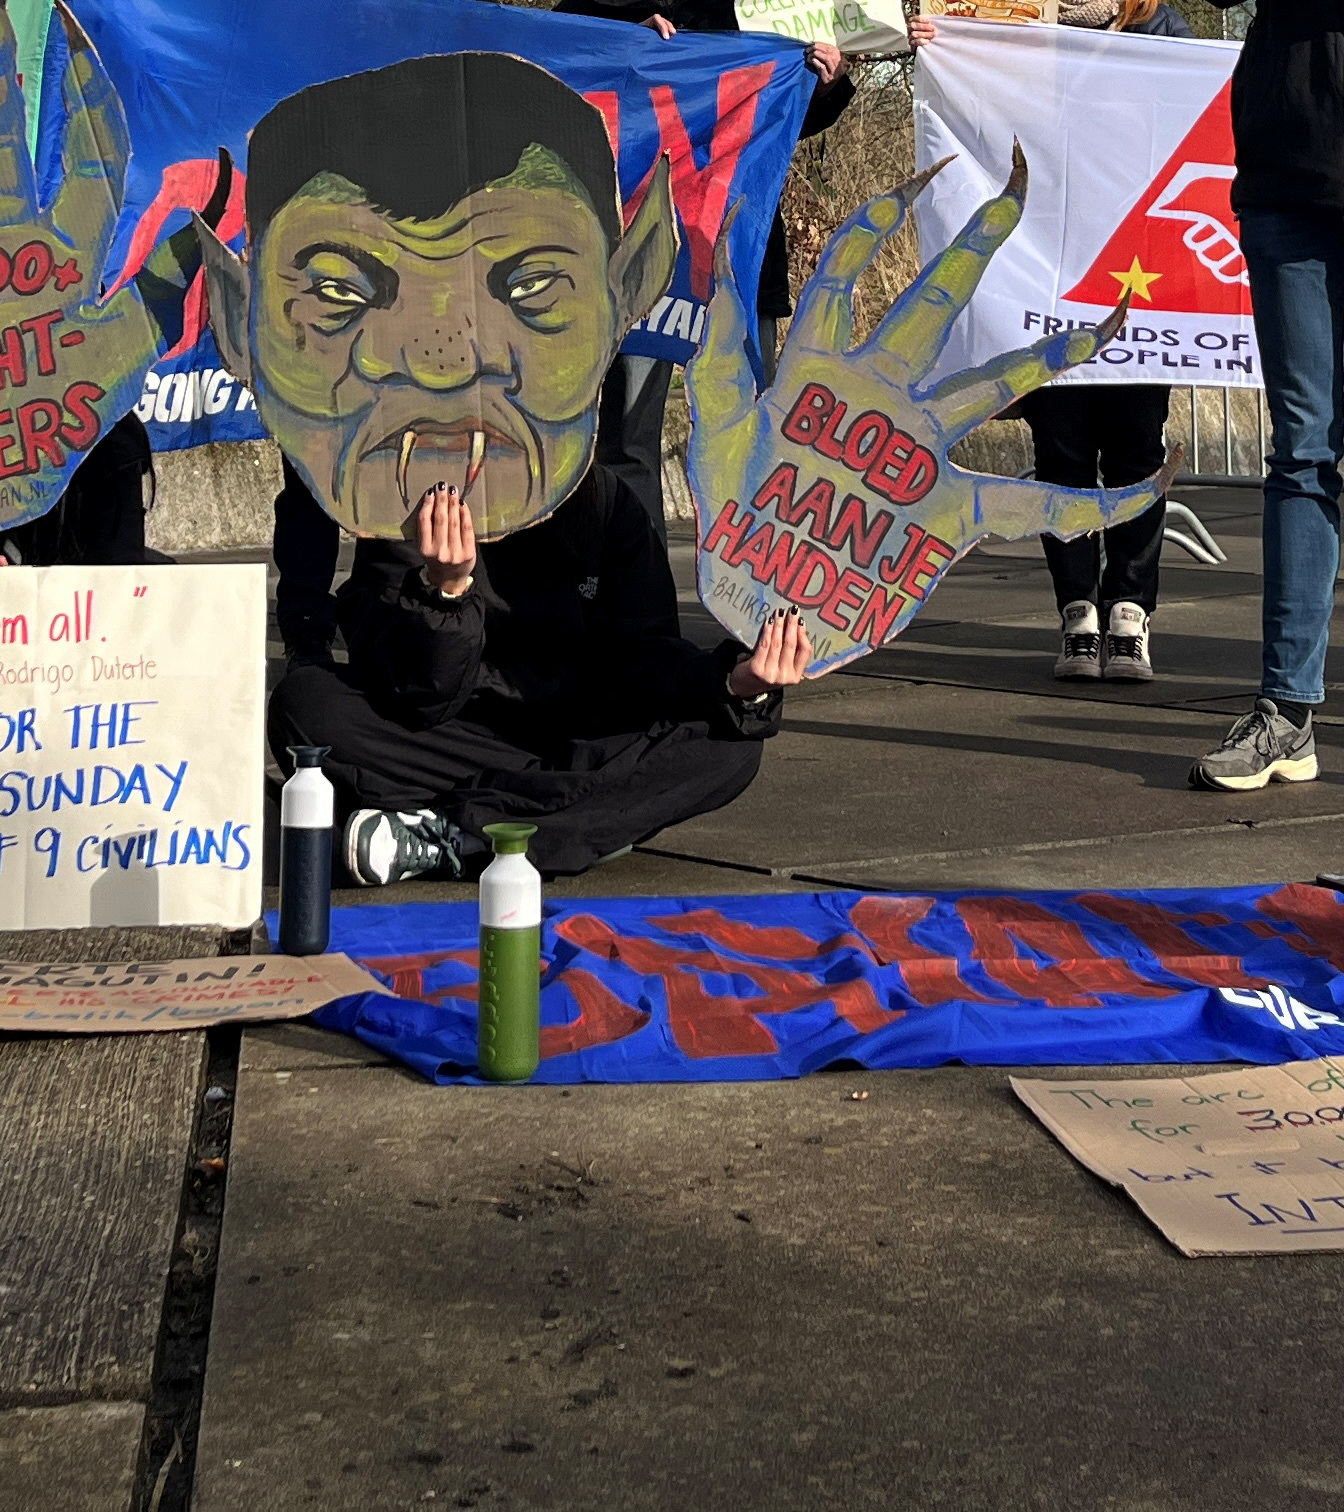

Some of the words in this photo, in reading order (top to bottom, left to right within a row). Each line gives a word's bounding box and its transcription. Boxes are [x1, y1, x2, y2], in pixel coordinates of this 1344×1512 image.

[771, 1, 876, 41] DAMAGE
[1194, 331, 1250, 351] OF
[1214, 355, 1253, 374] IN
[780, 382, 940, 507] BLOED
[750, 462, 894, 571] AAN
[878, 523, 957, 601] JE
[701, 498, 906, 650] HANDEN
[63, 700, 158, 750] THE
[0, 760, 188, 818] SUNDAY
[33, 827, 60, 878] 9
[1050, 1089, 1154, 1110] The
[1181, 1088, 1265, 1106] arc
[1127, 1118, 1200, 1144] for
[1128, 1165, 1216, 1183] but
